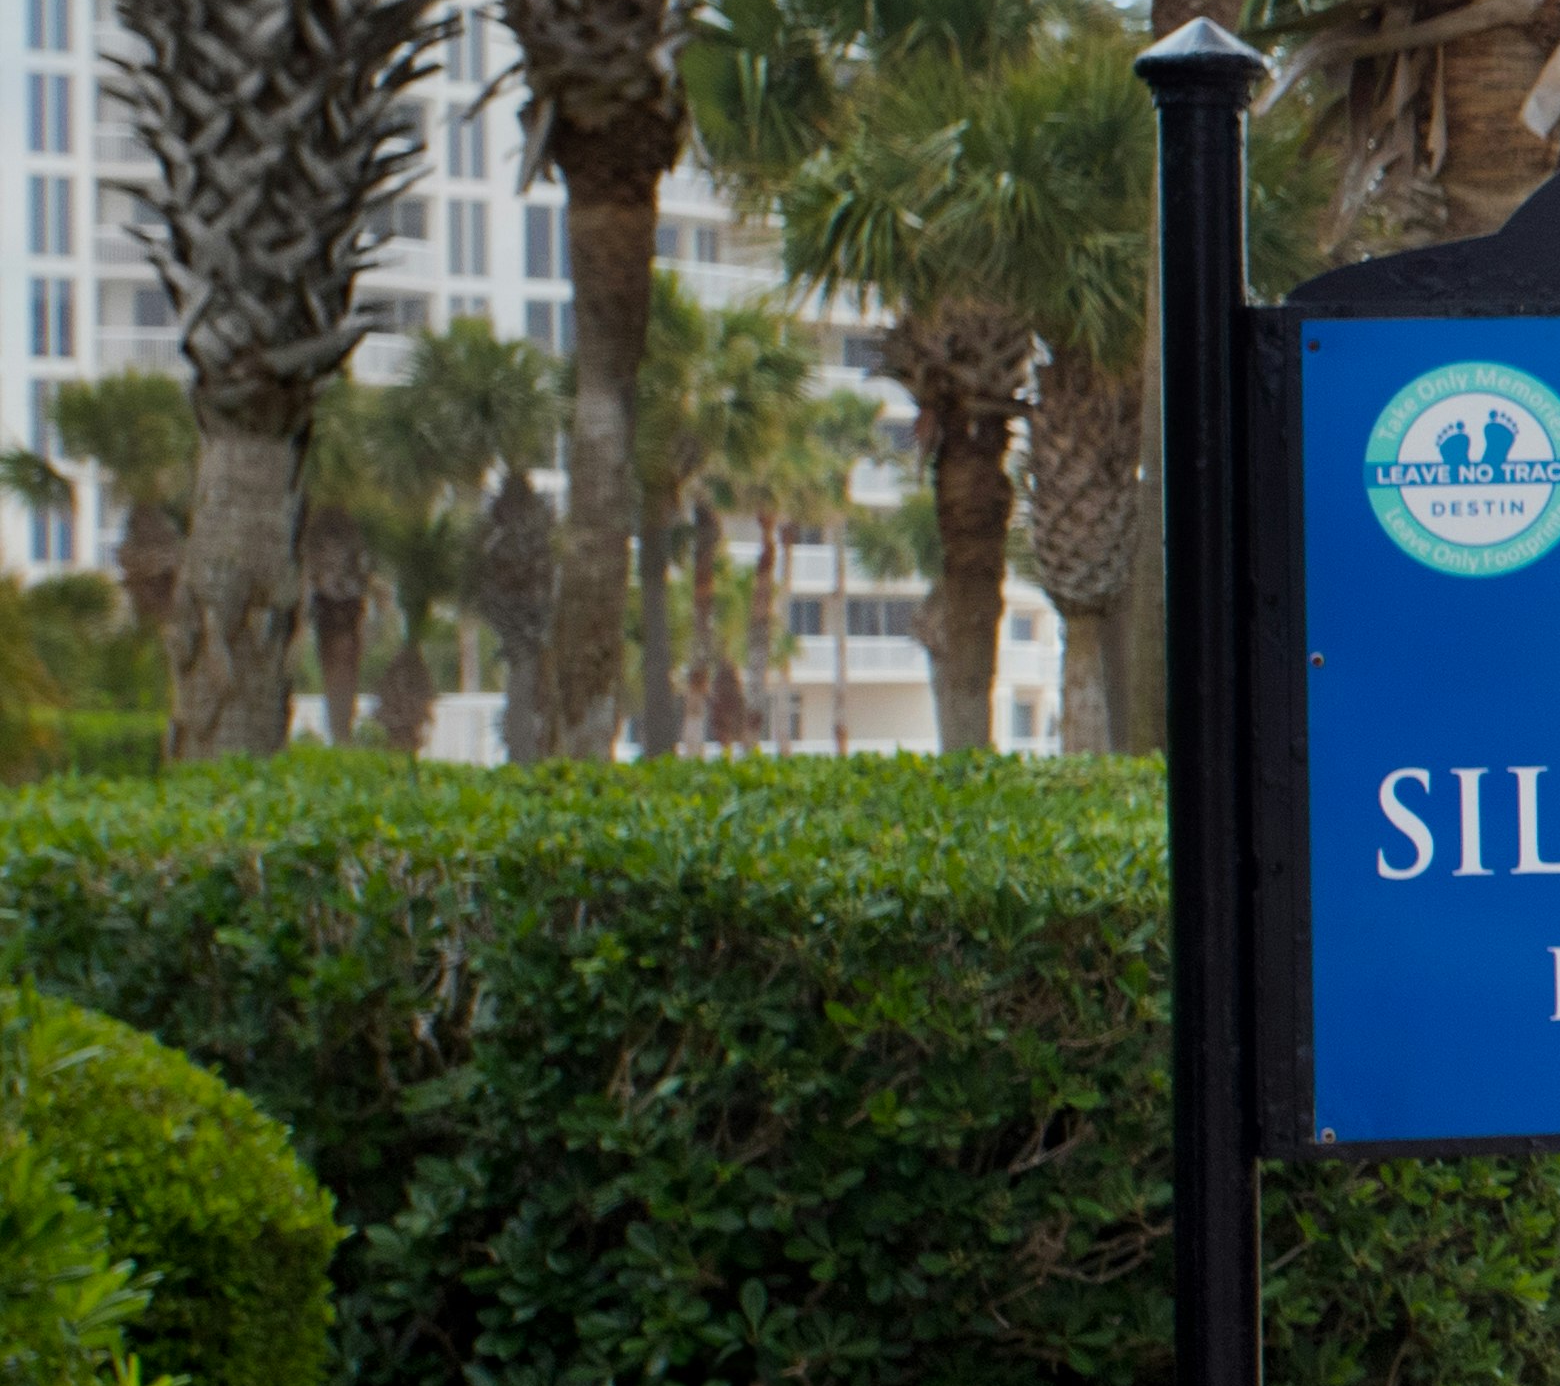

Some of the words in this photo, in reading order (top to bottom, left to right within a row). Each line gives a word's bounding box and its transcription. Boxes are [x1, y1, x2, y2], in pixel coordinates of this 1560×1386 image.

[1379, 399, 1417, 440] Take
[1417, 371, 1468, 401] Only
[1376, 464, 1450, 485] LEAVE
[1458, 464, 1494, 483] NO
[1431, 501, 1525, 517] DESTIN
[1386, 508, 1431, 556] Leave
[1433, 548, 1478, 574] Only
